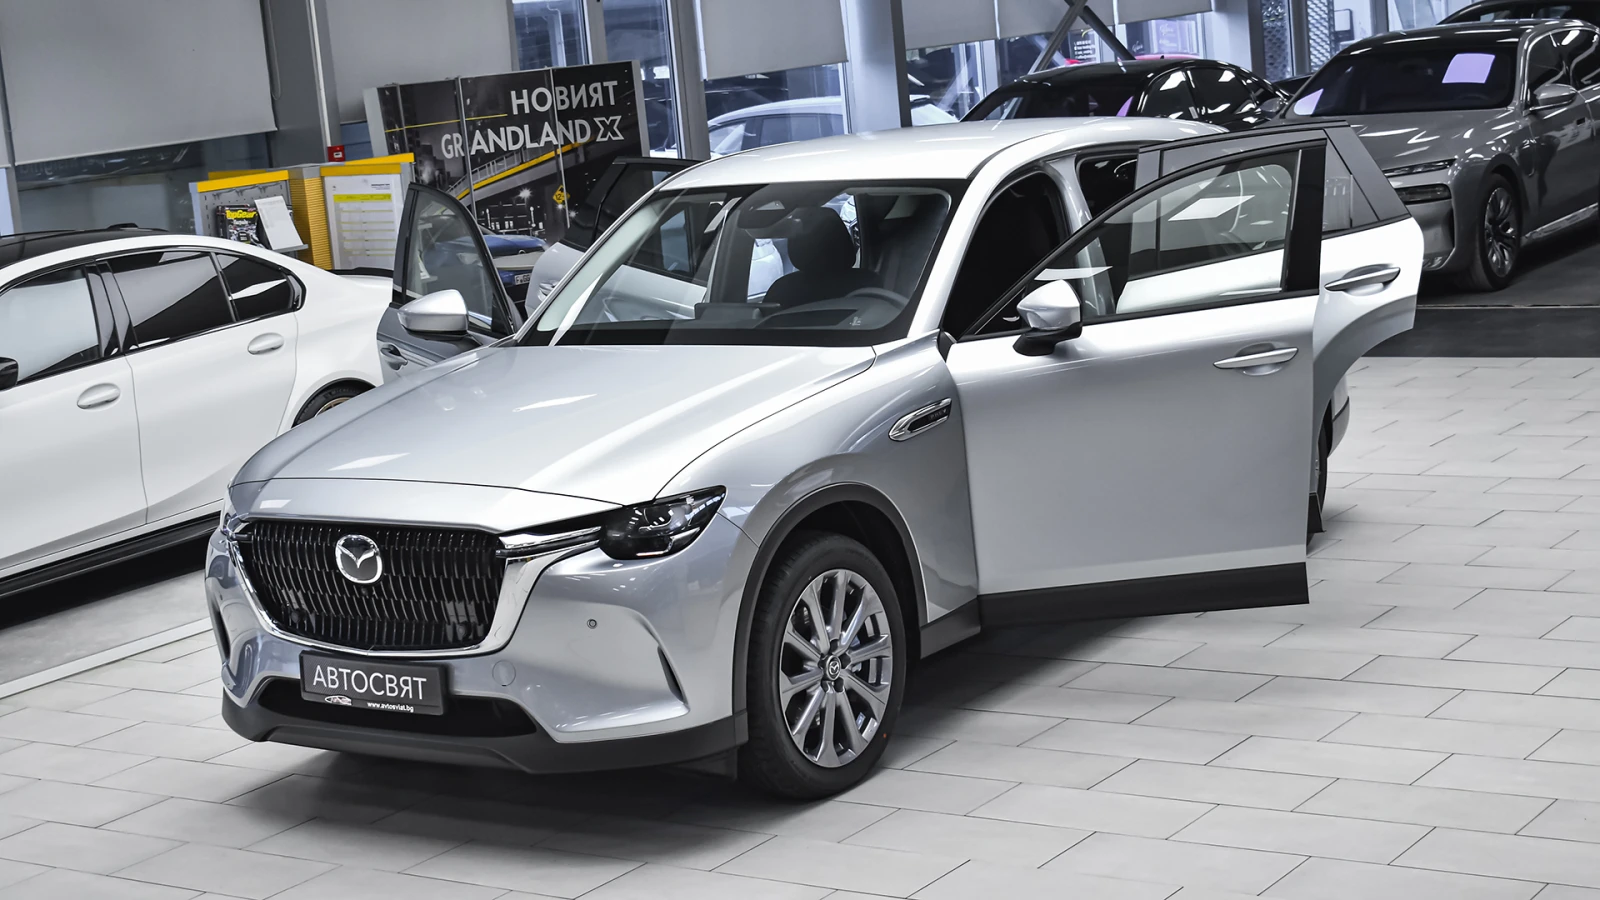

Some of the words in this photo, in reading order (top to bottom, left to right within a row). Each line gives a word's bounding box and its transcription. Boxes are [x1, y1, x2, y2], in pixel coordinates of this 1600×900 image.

[510, 80, 618, 115] НОВИЯТ
[441, 119, 591, 159] GRANDLAND
[225, 210, 257, 220] TopGear
[312, 664, 427, 700] АВТОСВЯТ
[366, 701, 414, 713] www.avtosviat.bg
